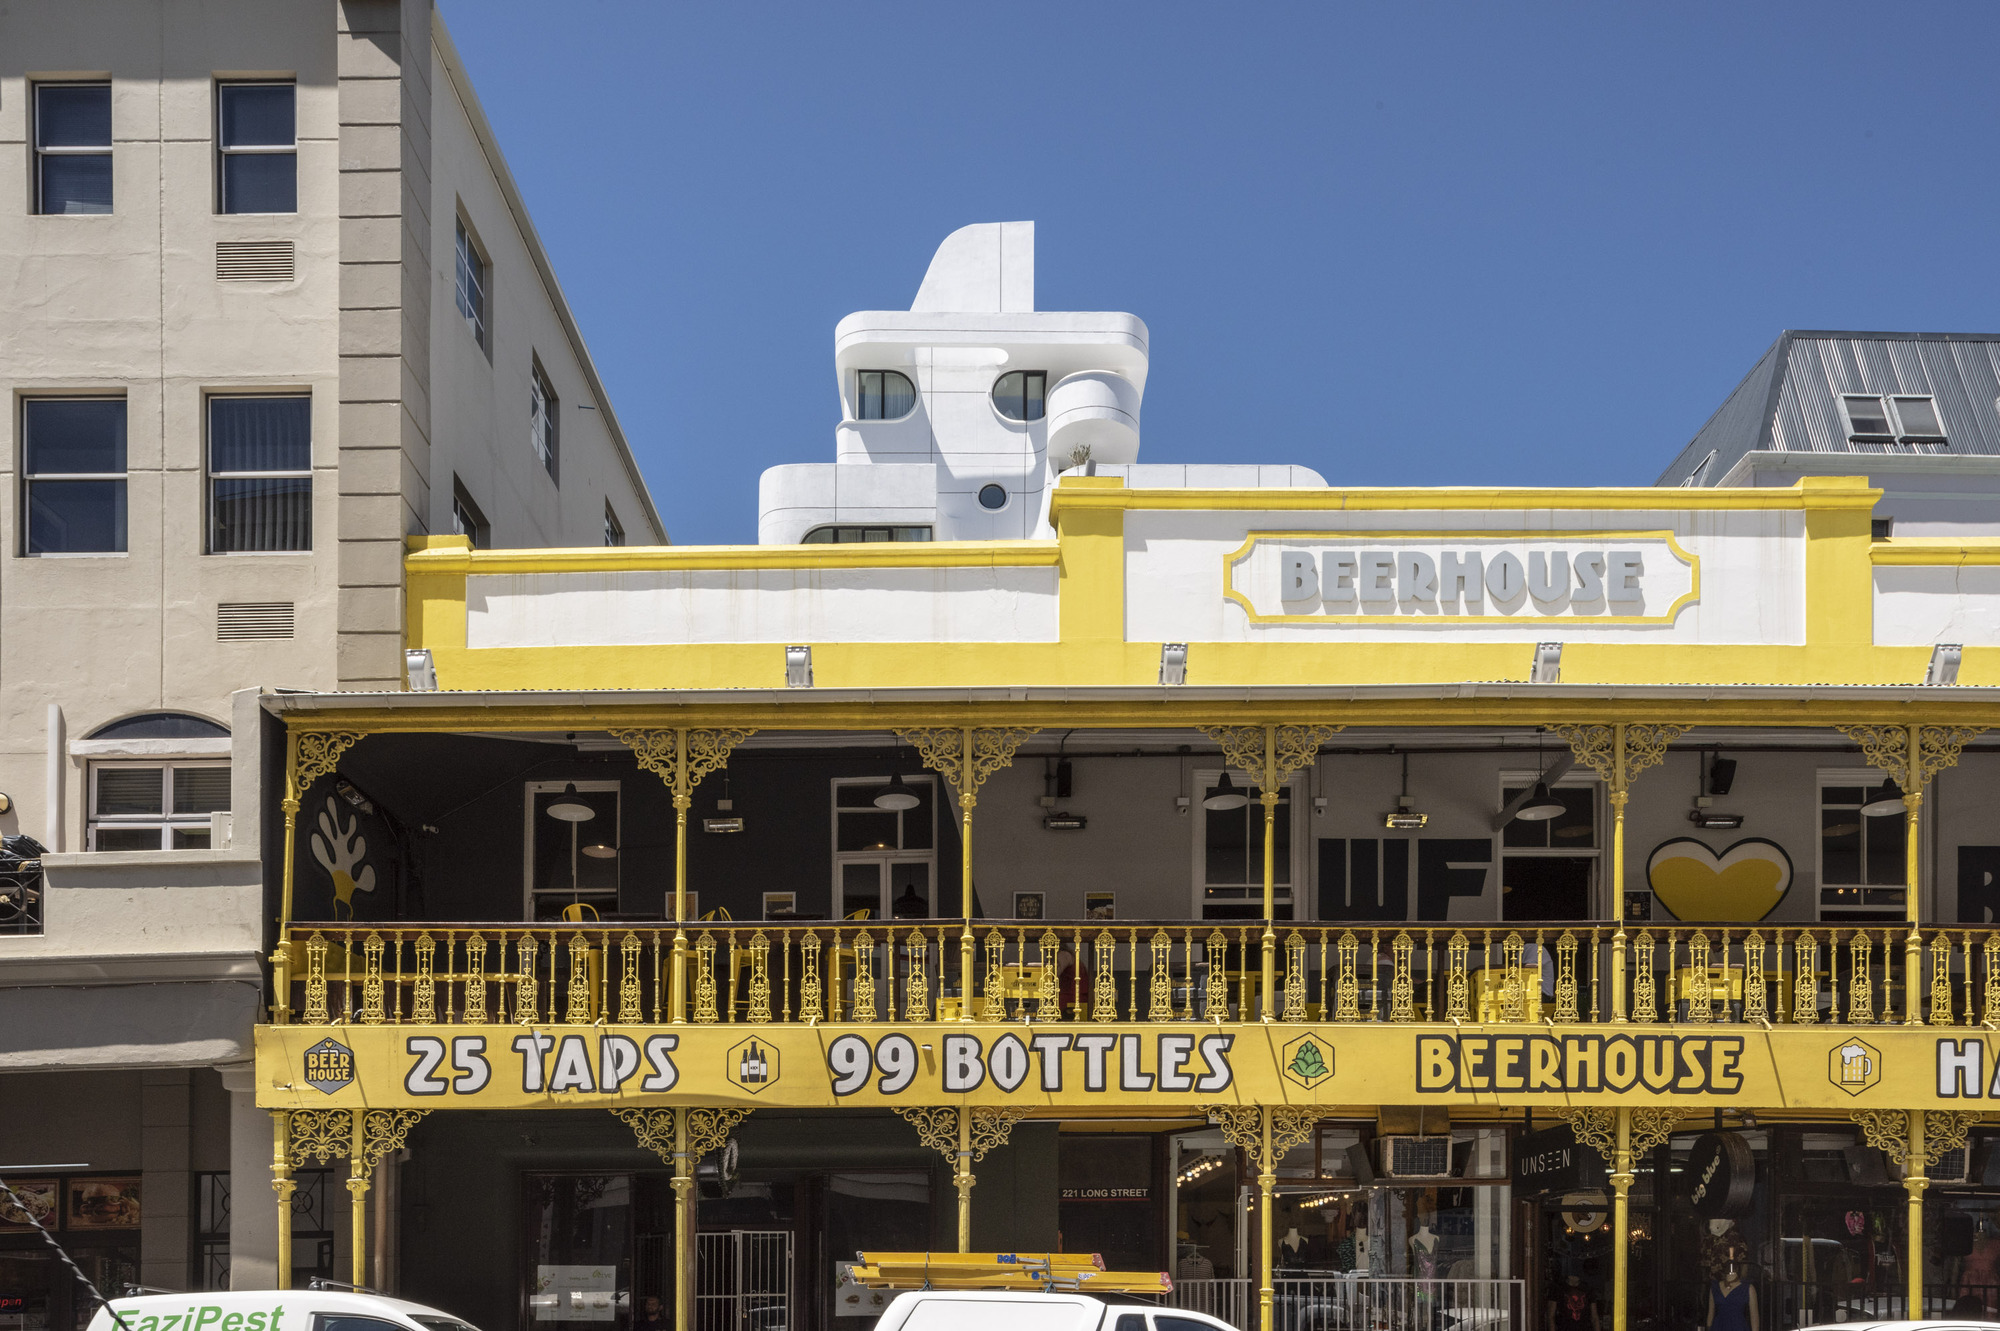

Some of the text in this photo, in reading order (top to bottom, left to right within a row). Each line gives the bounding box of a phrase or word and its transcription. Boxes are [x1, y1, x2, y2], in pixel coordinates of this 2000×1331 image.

[1281, 551, 1643, 602] BEERHOUSE
[308, 1053, 350, 1068] BEER
[404, 1034, 680, 1096] 25 TAPS
[827, 1033, 1235, 1096] 99 BOTTLES
[1416, 1033, 1745, 1095] BEERHOUSE
[1936, 1038, 2000, 1099] H
[308, 1069, 350, 1081] HOUSE
[1521, 1148, 1570, 1176] UNSEEN
[1062, 1188, 1148, 1198] 221 LONG STREET
[1690, 1183, 1706, 1205] big
[0, 1298, 22, 1308] pen
[111, 1305, 285, 1331] EaziPest
